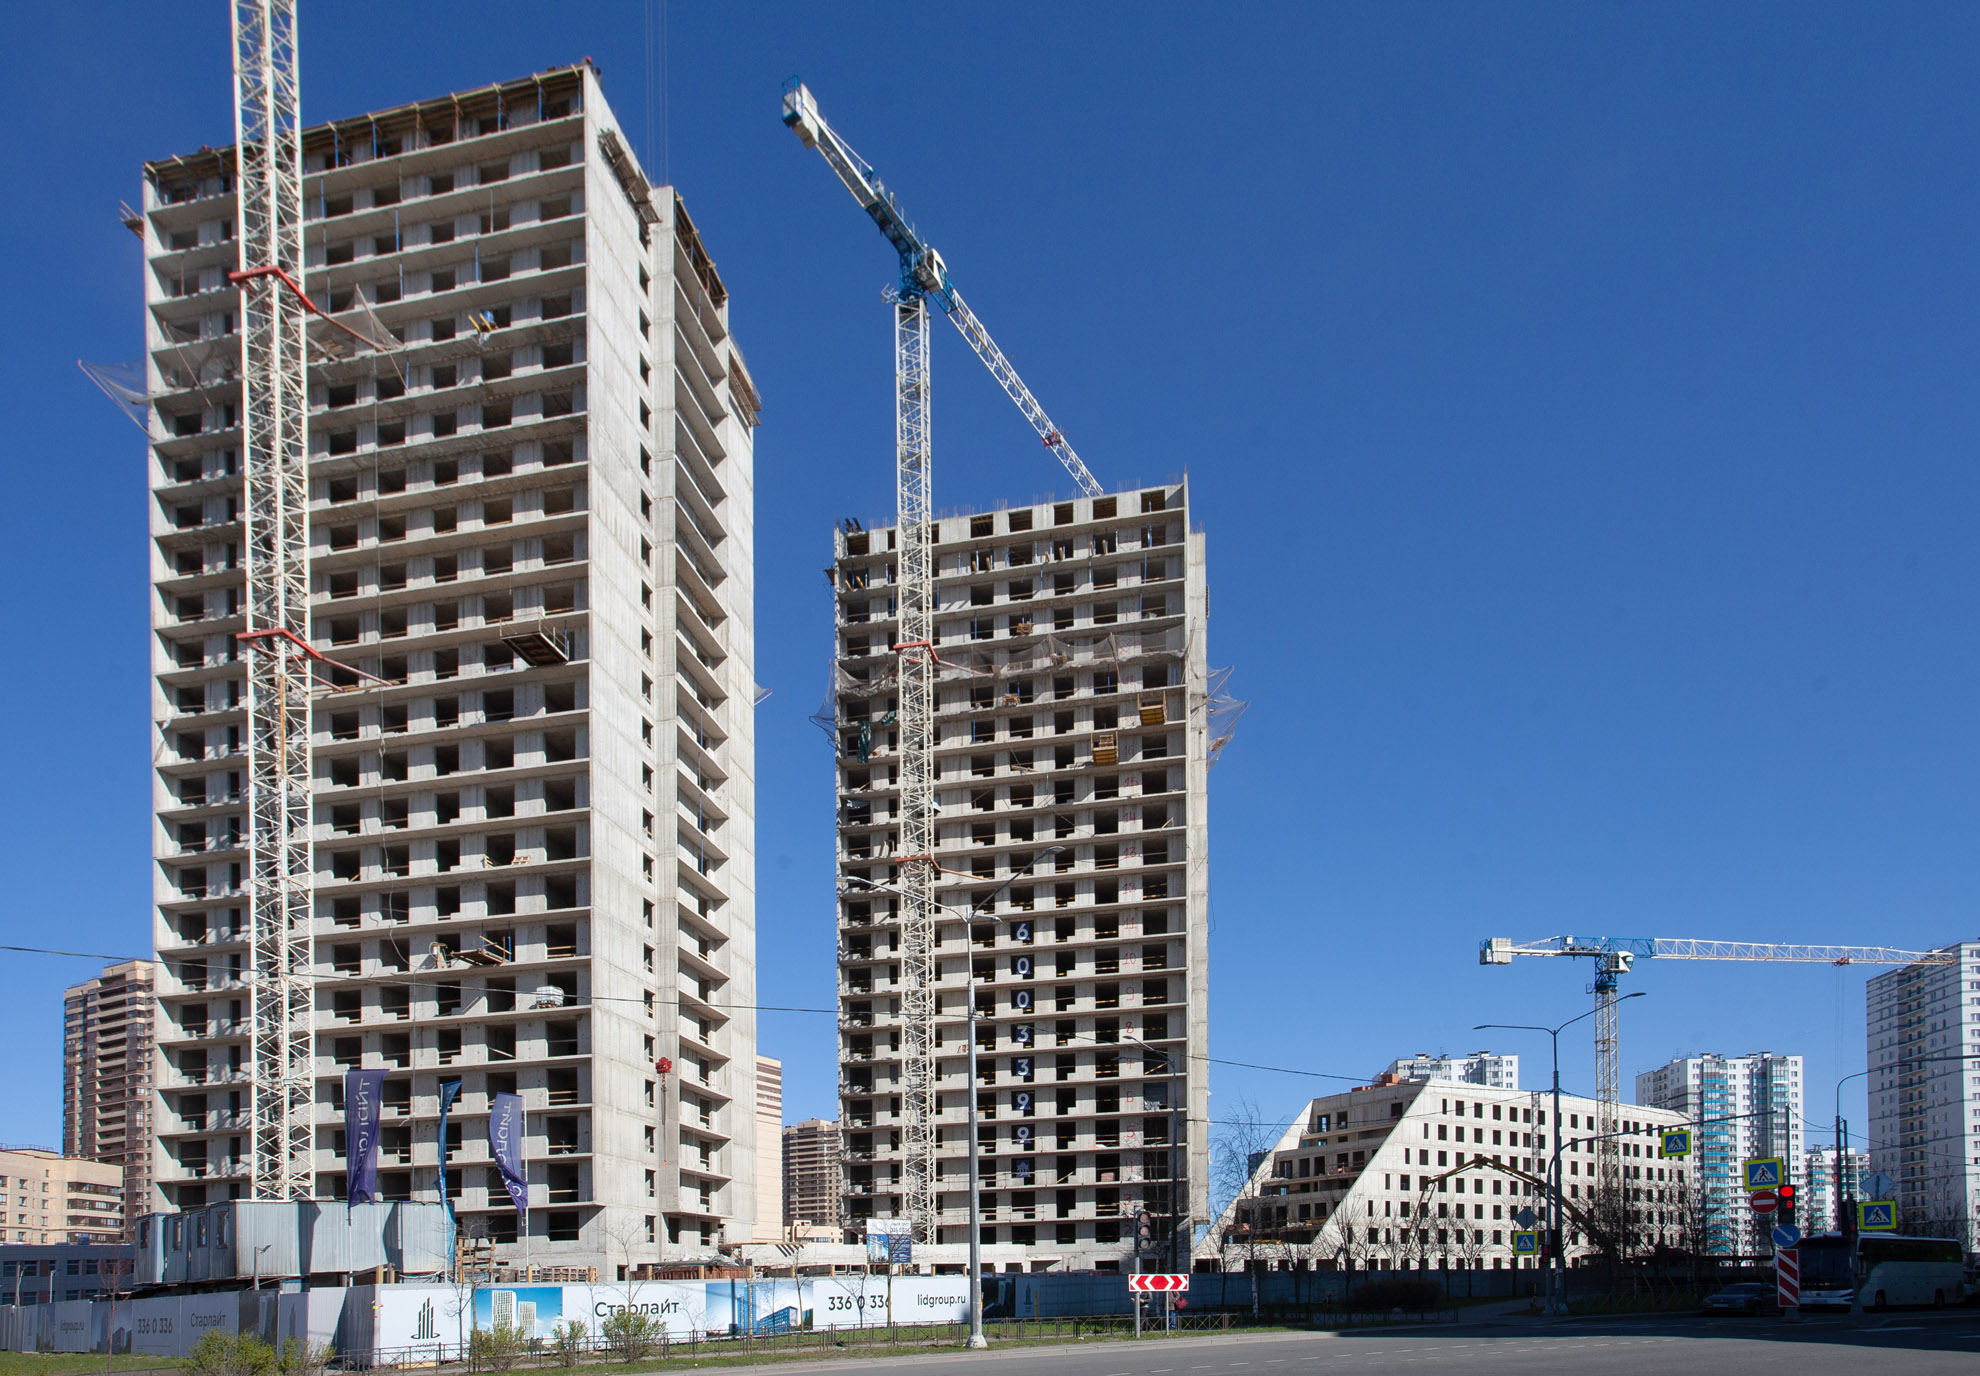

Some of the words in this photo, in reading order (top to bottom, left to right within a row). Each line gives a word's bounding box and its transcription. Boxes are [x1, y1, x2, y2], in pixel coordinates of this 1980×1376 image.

[1124, 776, 1138, 788] 15
[1122, 811, 1136, 824] 14
[1123, 846, 1137, 859] 13
[1123, 916, 1137, 930] 11
[1016, 923, 1029, 940] 6
[1017, 957, 1030, 975] 0
[1122, 952, 1137, 966] 10
[1016, 991, 1029, 1008] 0
[1125, 986, 1135, 1001] 9
[1017, 1026, 1029, 1042] 3
[1125, 1021, 1135, 1034] 8
[1017, 1058, 1029, 1075] 3
[1017, 1093, 1029, 1110] 9
[1126, 1091, 1134, 1103] 6
[1017, 1126, 1029, 1143] 9
[1126, 1124, 1136, 1138] 5
[1125, 1159, 1134, 1173] 4
[594, 1298, 679, 1318] Старлайт
[828, 1295, 853, 1310] 336
[856, 1295, 866, 1309] 0
[917, 1293, 966, 1308] lidgroup.ru
[138, 1318, 150, 1334] 336
[152, 1317, 158, 1334] 0
[160, 1317, 173, 1334] 336
[190, 1310, 226, 1330] Старлайт
